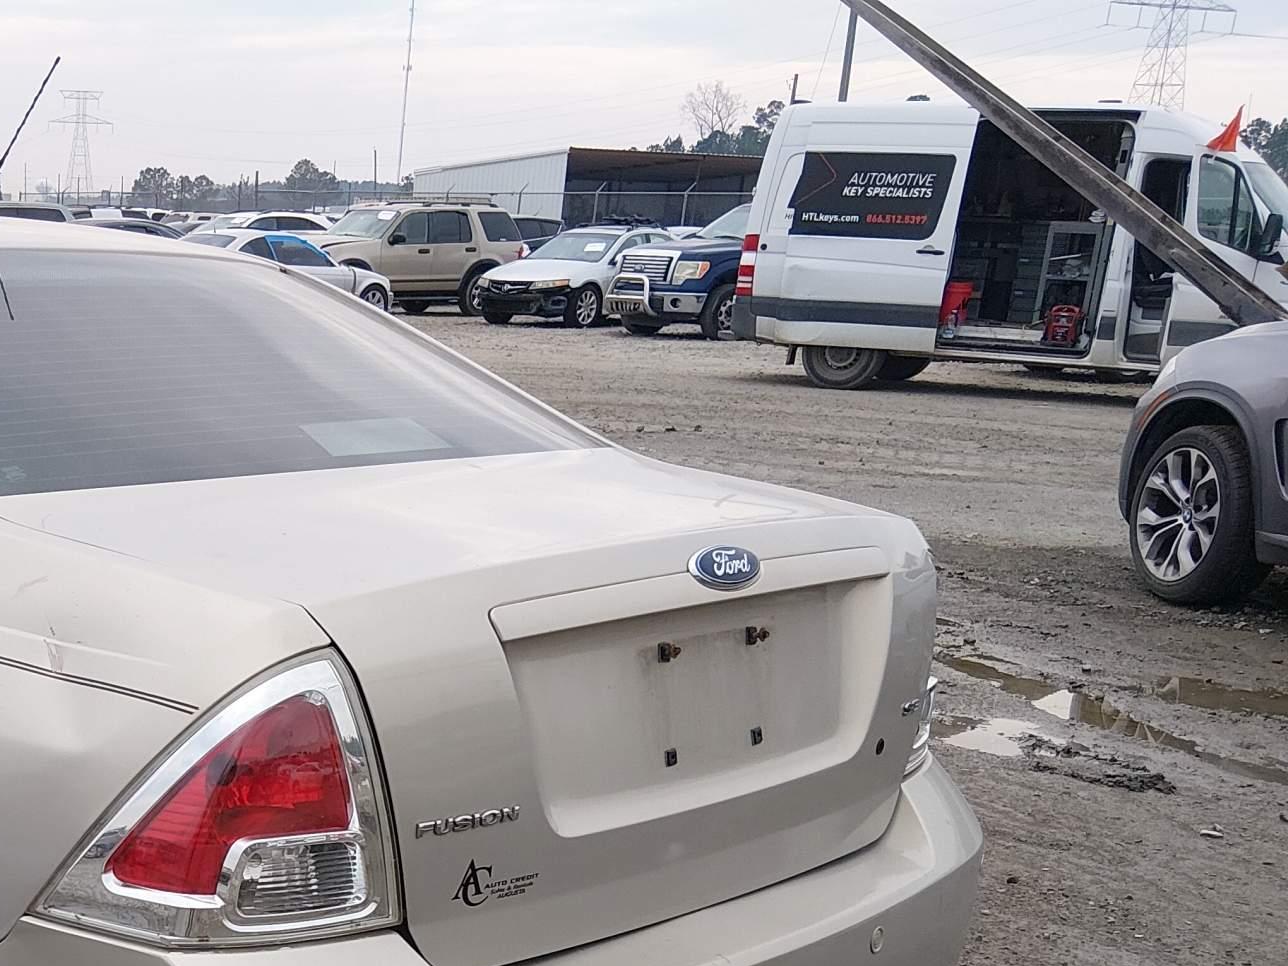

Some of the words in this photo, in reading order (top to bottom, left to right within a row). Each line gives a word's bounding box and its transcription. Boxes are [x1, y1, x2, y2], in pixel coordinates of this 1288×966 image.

[848, 172, 937, 186] AUTOMOTIVE
[842, 186, 865, 196] KEY
[866, 187, 933, 198] SPECIALISTS
[801, 212, 859, 223] HTLkeys.com
[712, 549, 751, 577] Ford
[416, 805, 521, 840] FUSION
[483, 879, 508, 890] AUTO
[510, 872, 540, 884] CREDIT
